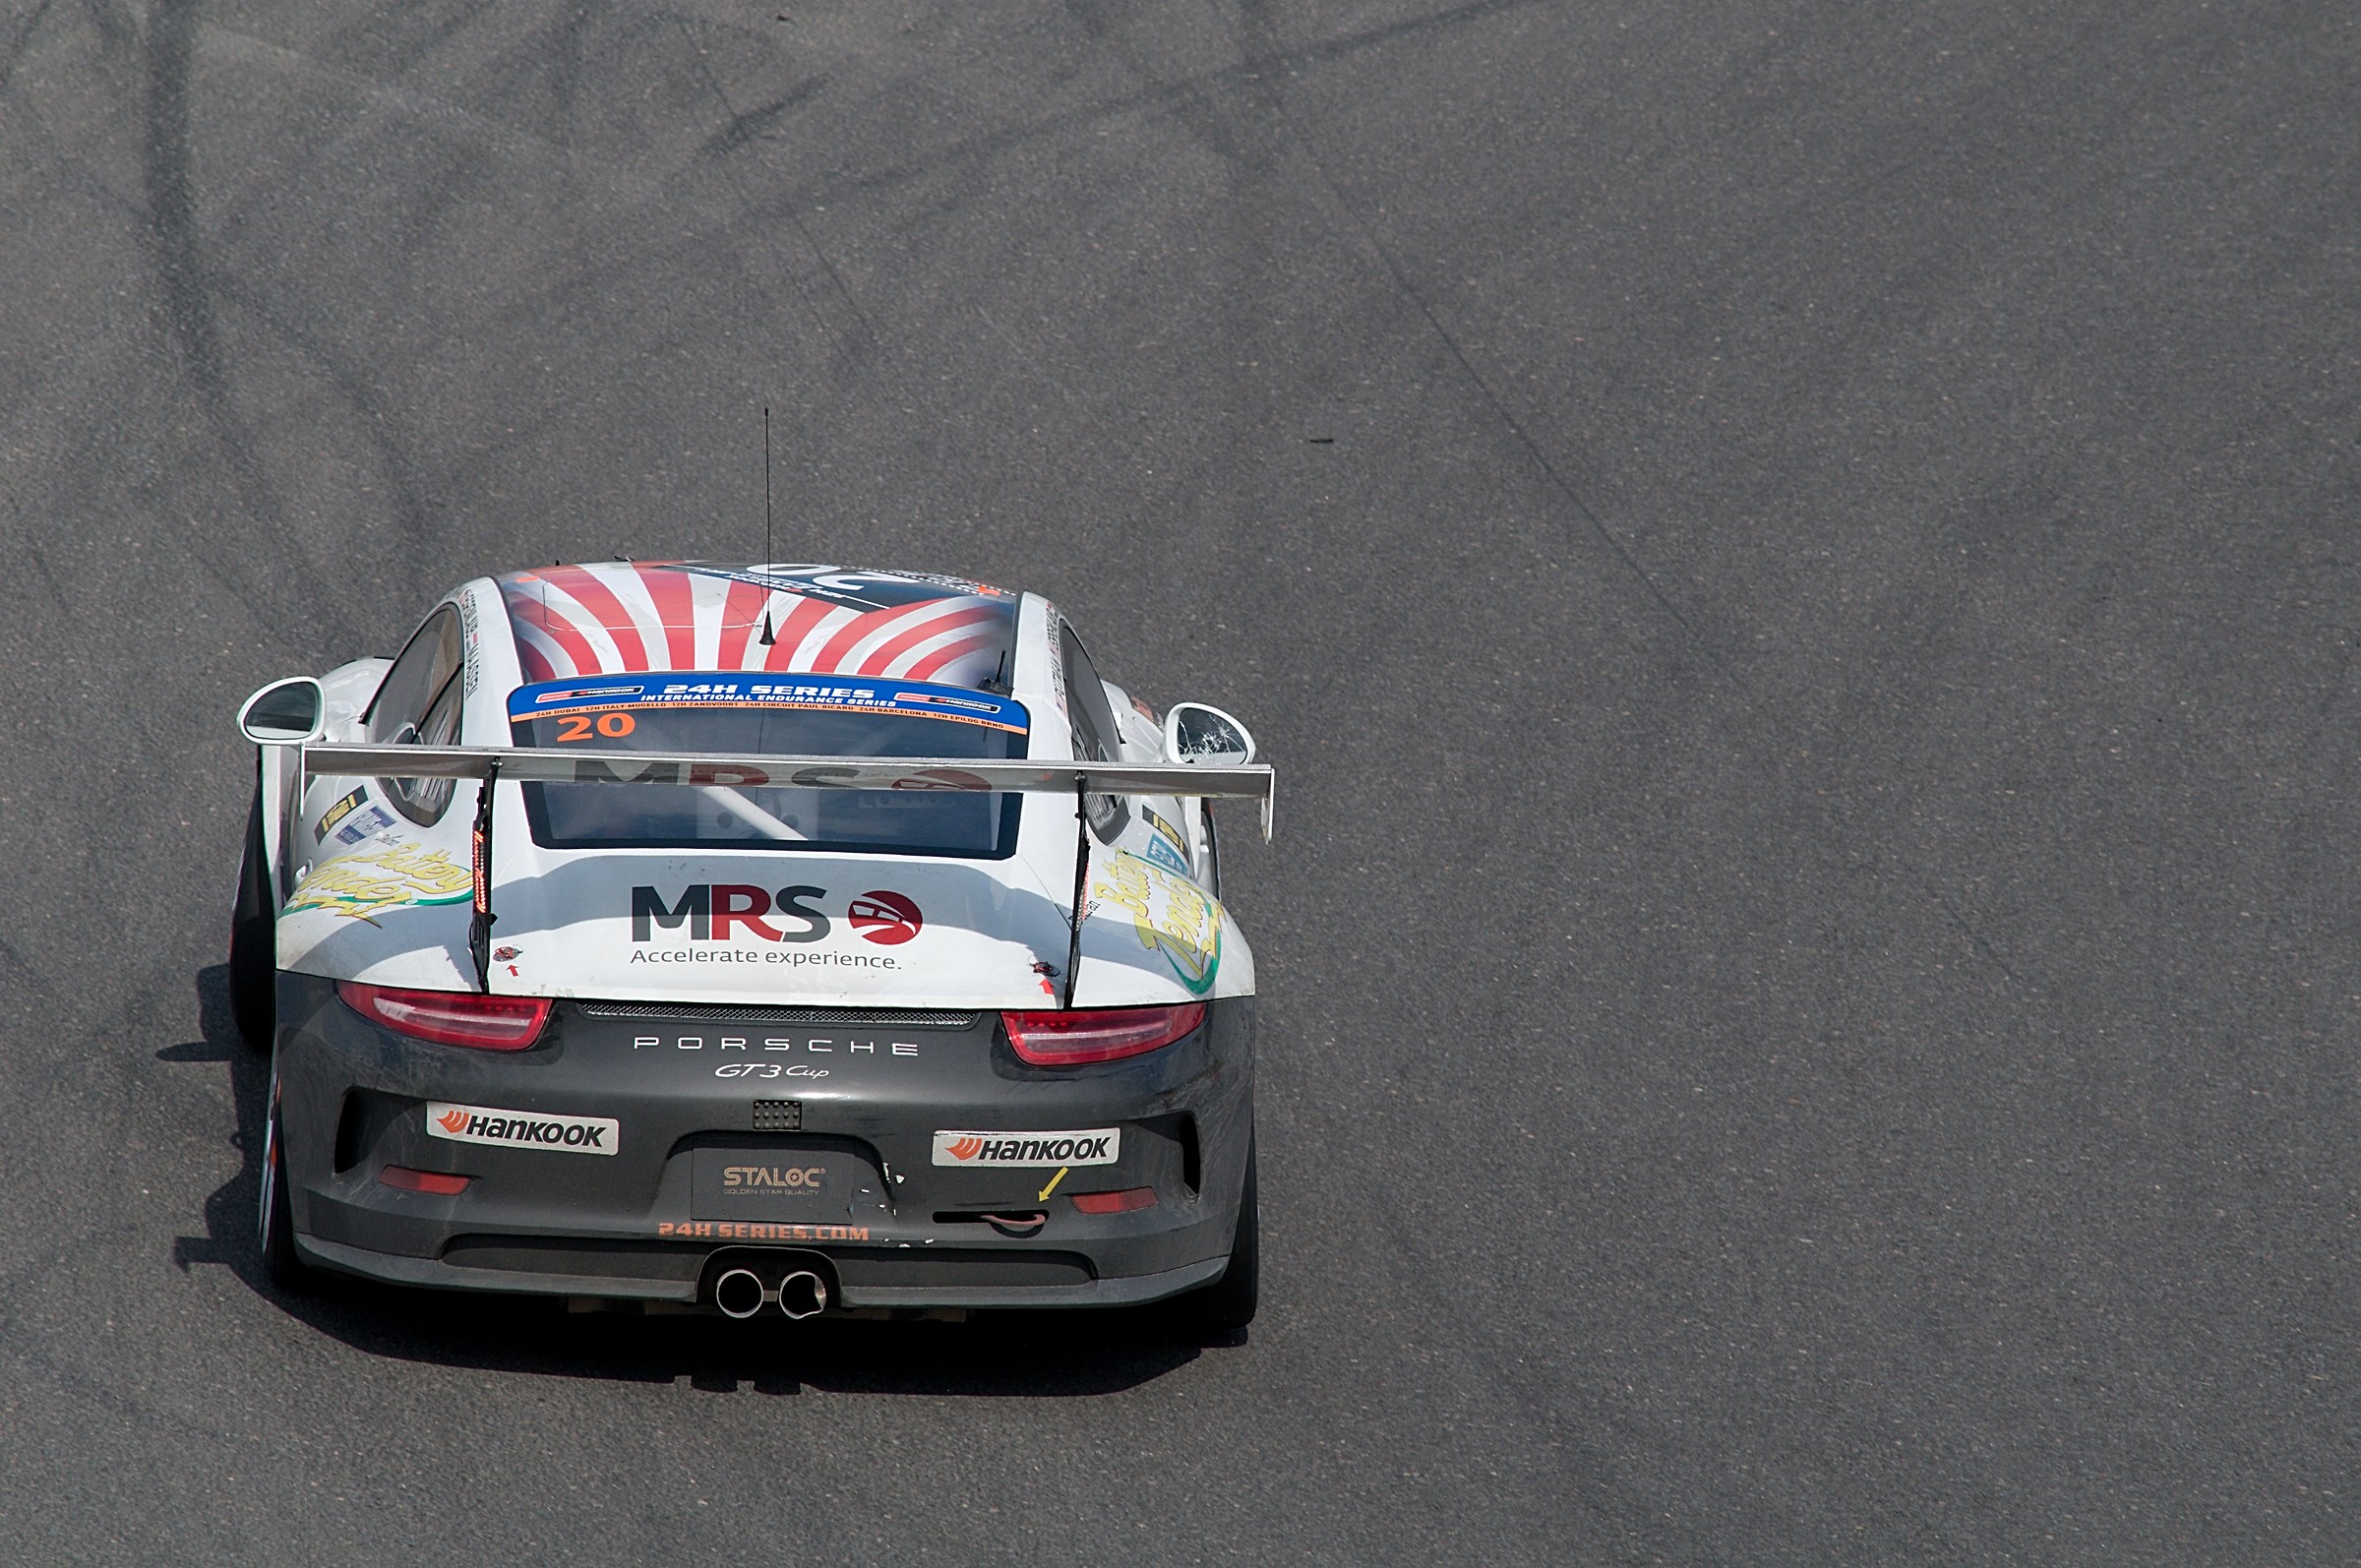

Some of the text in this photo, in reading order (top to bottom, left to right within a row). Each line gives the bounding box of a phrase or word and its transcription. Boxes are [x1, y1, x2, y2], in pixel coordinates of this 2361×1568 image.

[663, 684, 875, 699] 24H SERIES
[757, 694, 844, 704] ENDURANCE
[846, 697, 897, 707] SERIES
[557, 712, 636, 742] 20
[877, 707, 928, 717] BARCELONA
[950, 715, 979, 724] EPILOG
[980, 719, 1004, 729] BRNO
[632, 883, 831, 943] MRS
[630, 948, 902, 970] Accelerate experience.
[633, 1036, 919, 1056] PORSCHE
[785, 1064, 830, 1080] Cup
[658, 1222, 712, 1236] 24H
